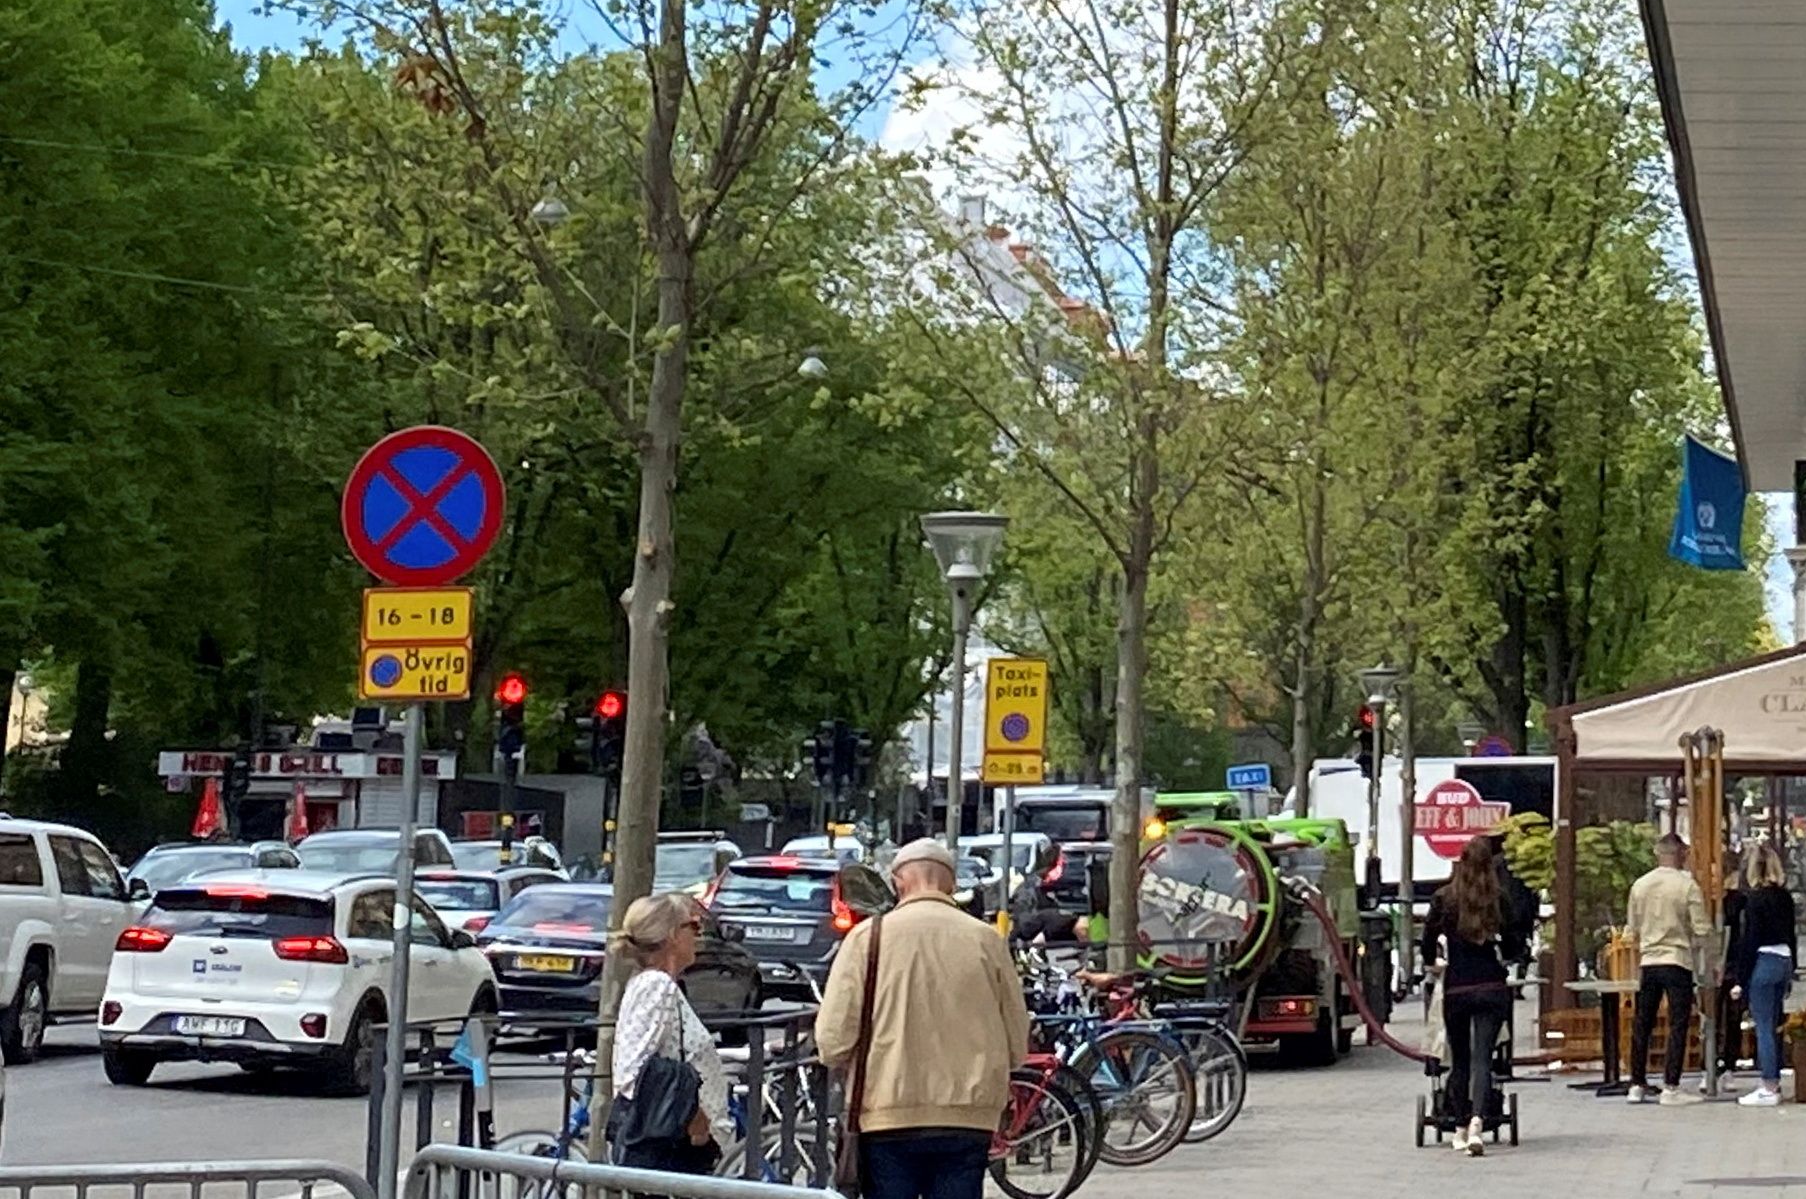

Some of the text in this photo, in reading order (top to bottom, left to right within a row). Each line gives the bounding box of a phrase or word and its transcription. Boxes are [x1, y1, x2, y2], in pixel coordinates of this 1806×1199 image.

[405, 648, 464, 675] Övrig
[995, 666, 1042, 681] Taxi-
[420, 675, 447, 693] tid
[995, 684, 1038, 701] plats
[1234, 771, 1265, 784] TAXI
[1444, 805, 1460, 829] &
